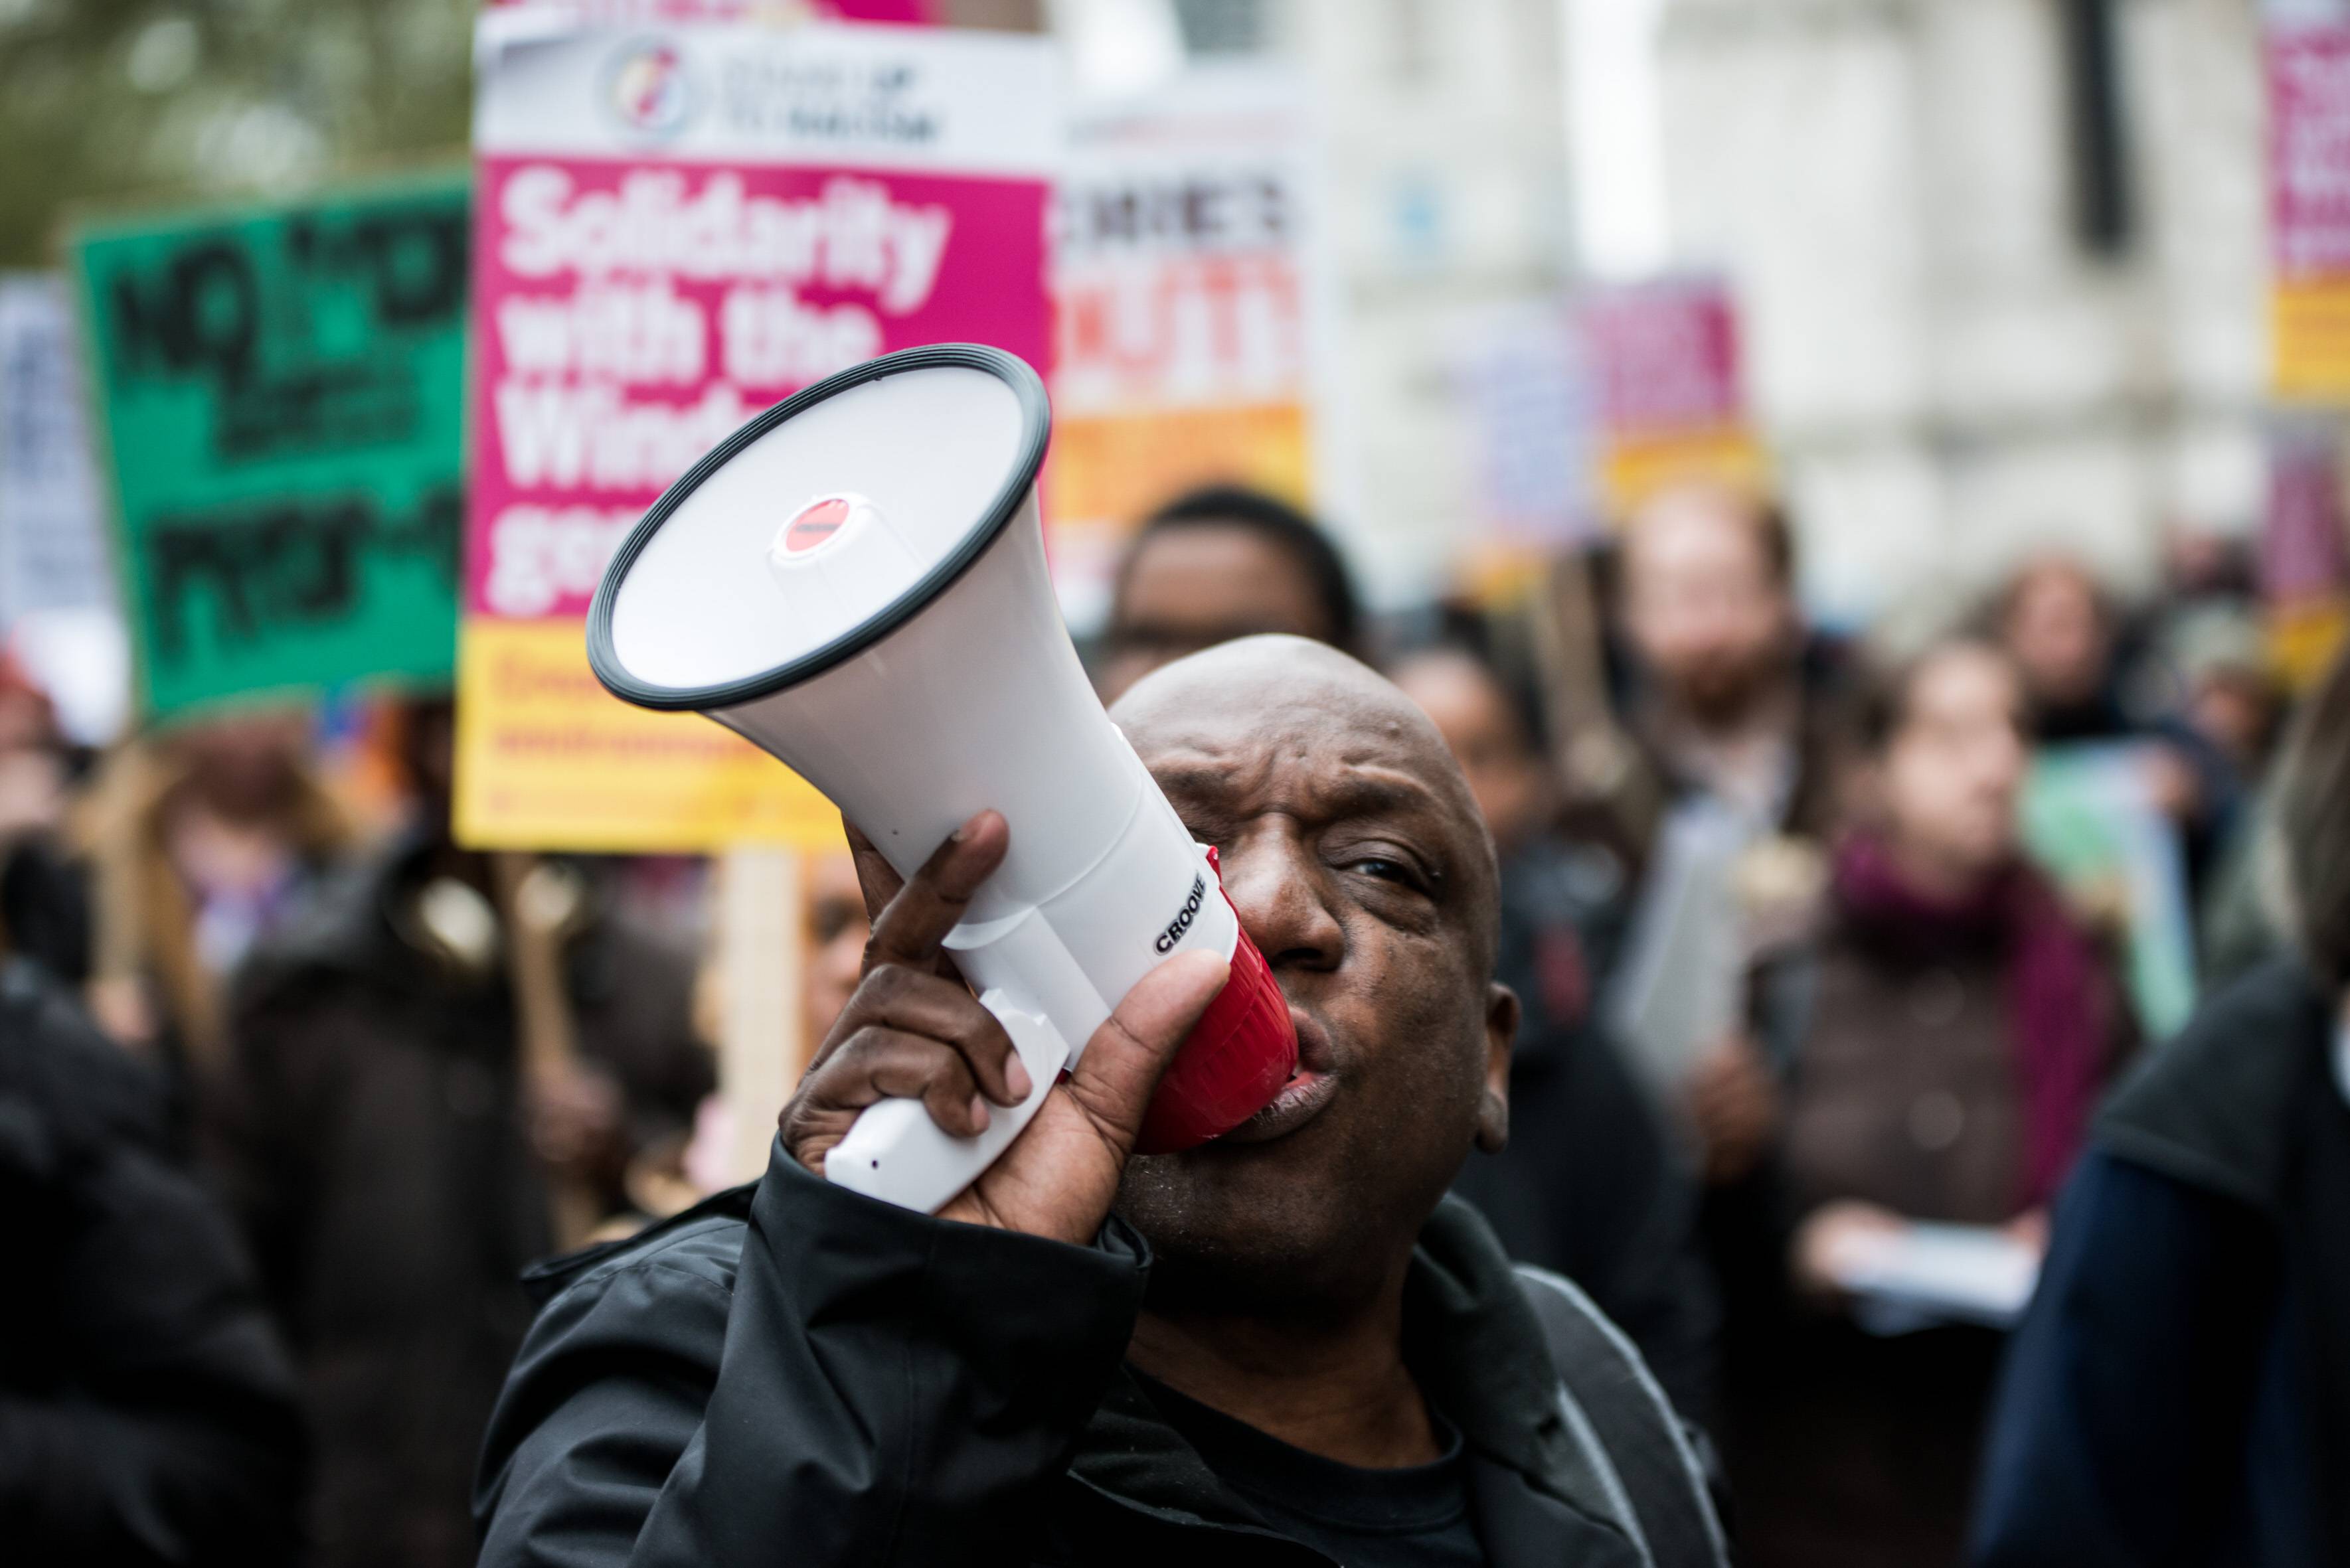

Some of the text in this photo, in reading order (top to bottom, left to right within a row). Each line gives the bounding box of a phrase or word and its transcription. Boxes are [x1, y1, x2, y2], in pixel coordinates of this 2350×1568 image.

[499, 164, 951, 315] Solidarity
[497, 274, 883, 386] with the
[493, 381, 774, 490] Wind
[1155, 870, 1207, 955] CROOVE
